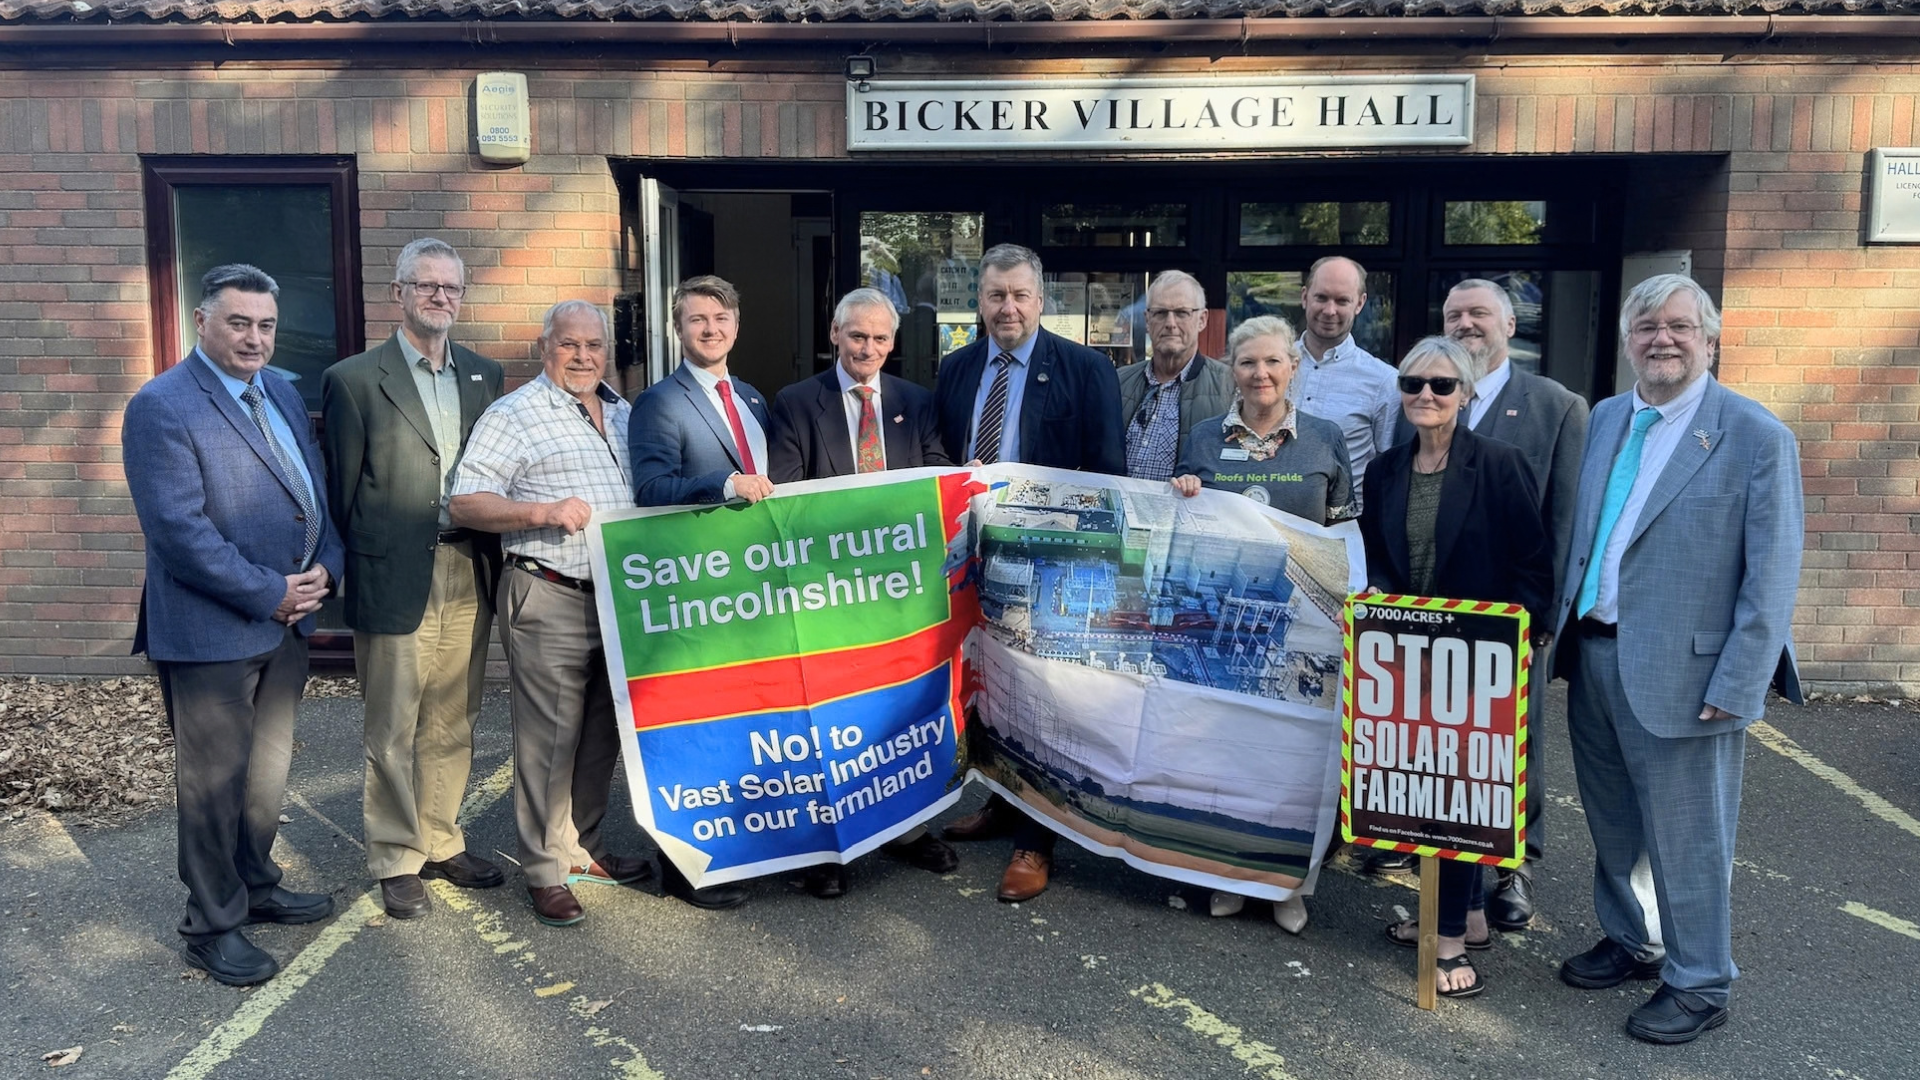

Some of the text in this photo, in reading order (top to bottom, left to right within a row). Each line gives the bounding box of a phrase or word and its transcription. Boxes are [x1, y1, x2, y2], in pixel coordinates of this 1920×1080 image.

[482, 85, 515, 95] Aegis
[863, 94, 1454, 131] BICKER VILLAGE HALL
[1887, 162, 1920, 175] HALL
[1214, 472, 1303, 482] Roofs Not Fields
[621, 512, 928, 590] Save our rural
[639, 560, 924, 634] Lincolnshire!
[1369, 606, 1401, 621] 7000
[1402, 610, 1443, 624] ACRES
[1358, 630, 1513, 729] STOP
[657, 715, 946, 812] Vast Solar Industry
[749, 725, 863, 766] No! to
[1353, 717, 1514, 783] SOLAR ON
[692, 752, 934, 841] on our farmland
[1353, 766, 1513, 830] FARMLAND
[1397, 829, 1425, 838] Facebook
[1431, 835, 1495, 849] www.7000acres.co.uk
